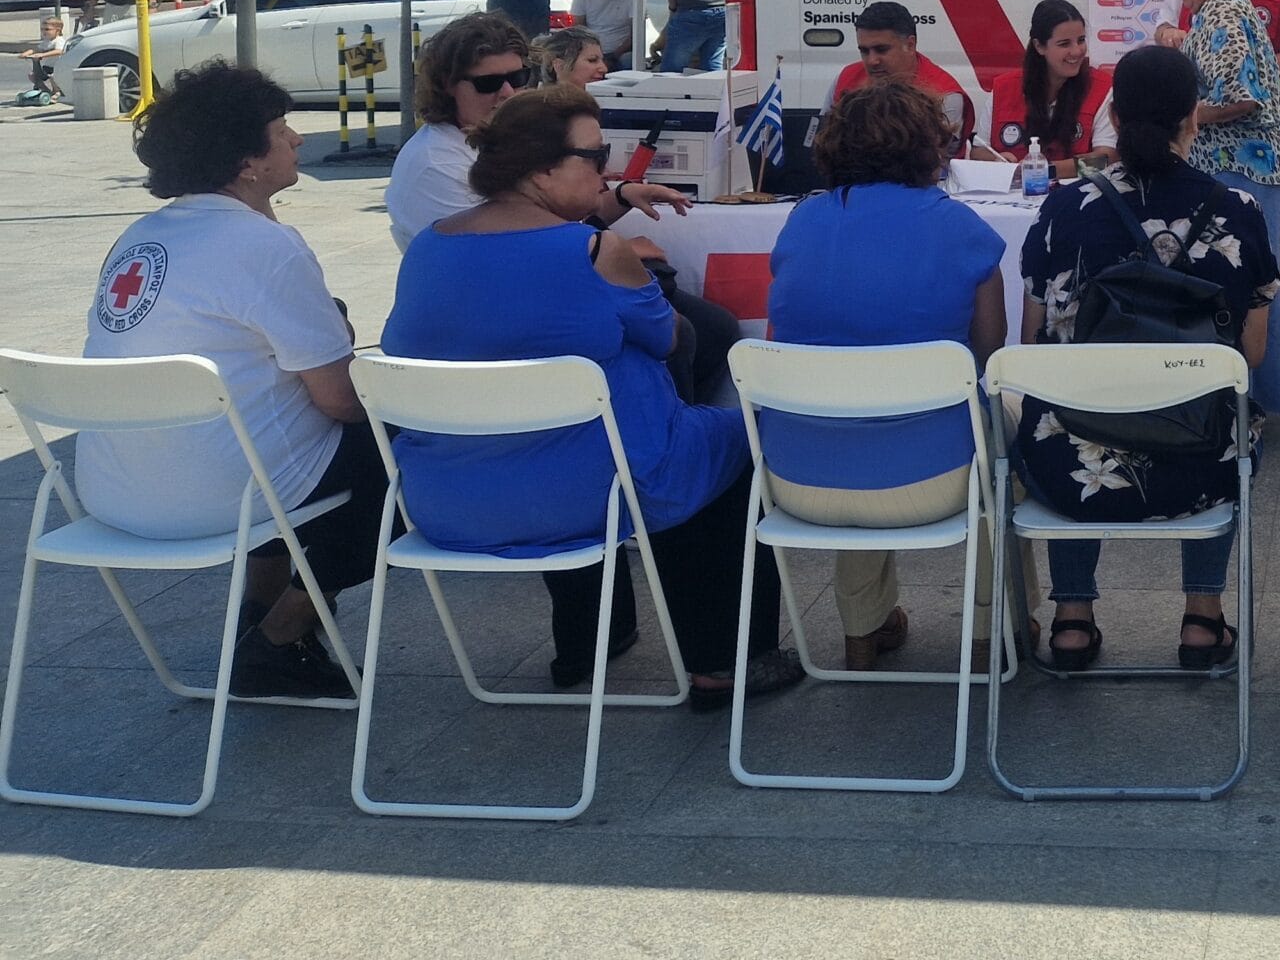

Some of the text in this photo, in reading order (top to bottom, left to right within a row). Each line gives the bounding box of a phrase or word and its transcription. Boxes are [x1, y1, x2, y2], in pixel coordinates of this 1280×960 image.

[804, 11, 936, 26] Spanish oss
[114, 318, 126, 330] RED
[128, 298, 151, 325] CROSS
